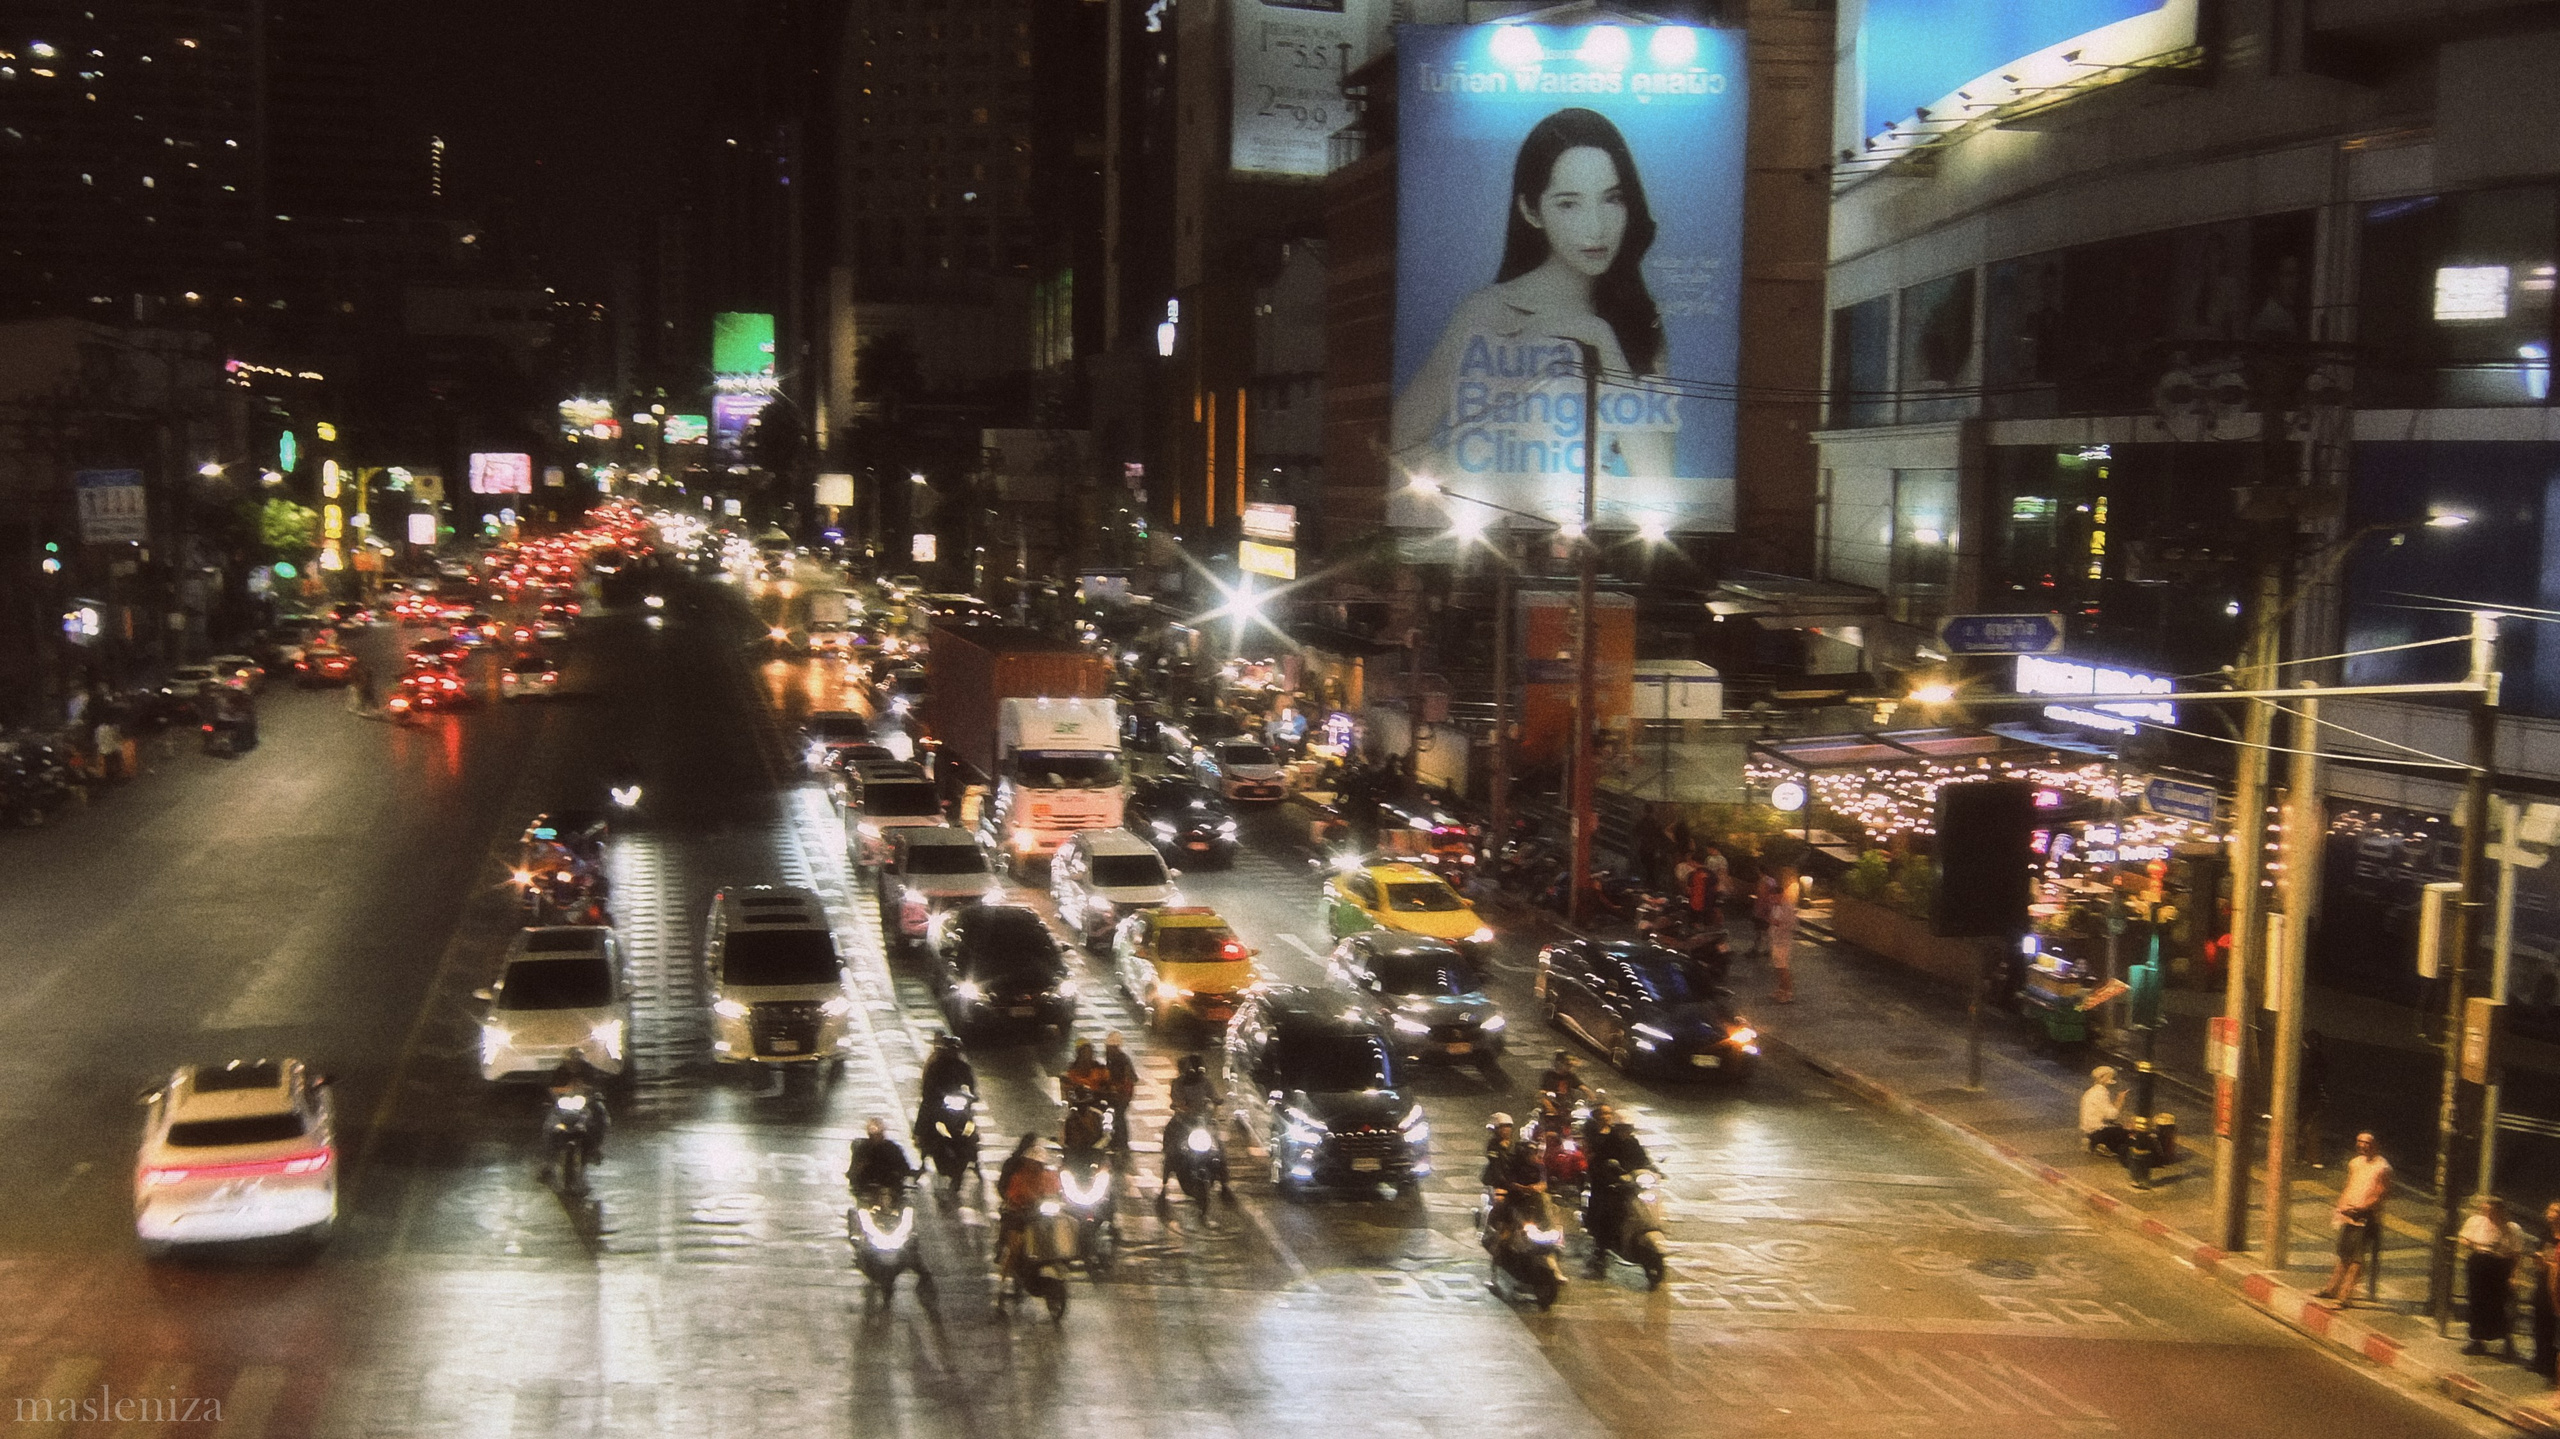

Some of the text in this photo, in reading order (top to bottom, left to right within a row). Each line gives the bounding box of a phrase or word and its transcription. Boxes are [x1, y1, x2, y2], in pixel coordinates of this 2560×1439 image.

[1460, 334, 1574, 377] Aura
[1457, 381, 1674, 438] Bangkok
[1457, 427, 1587, 474] Clinic
